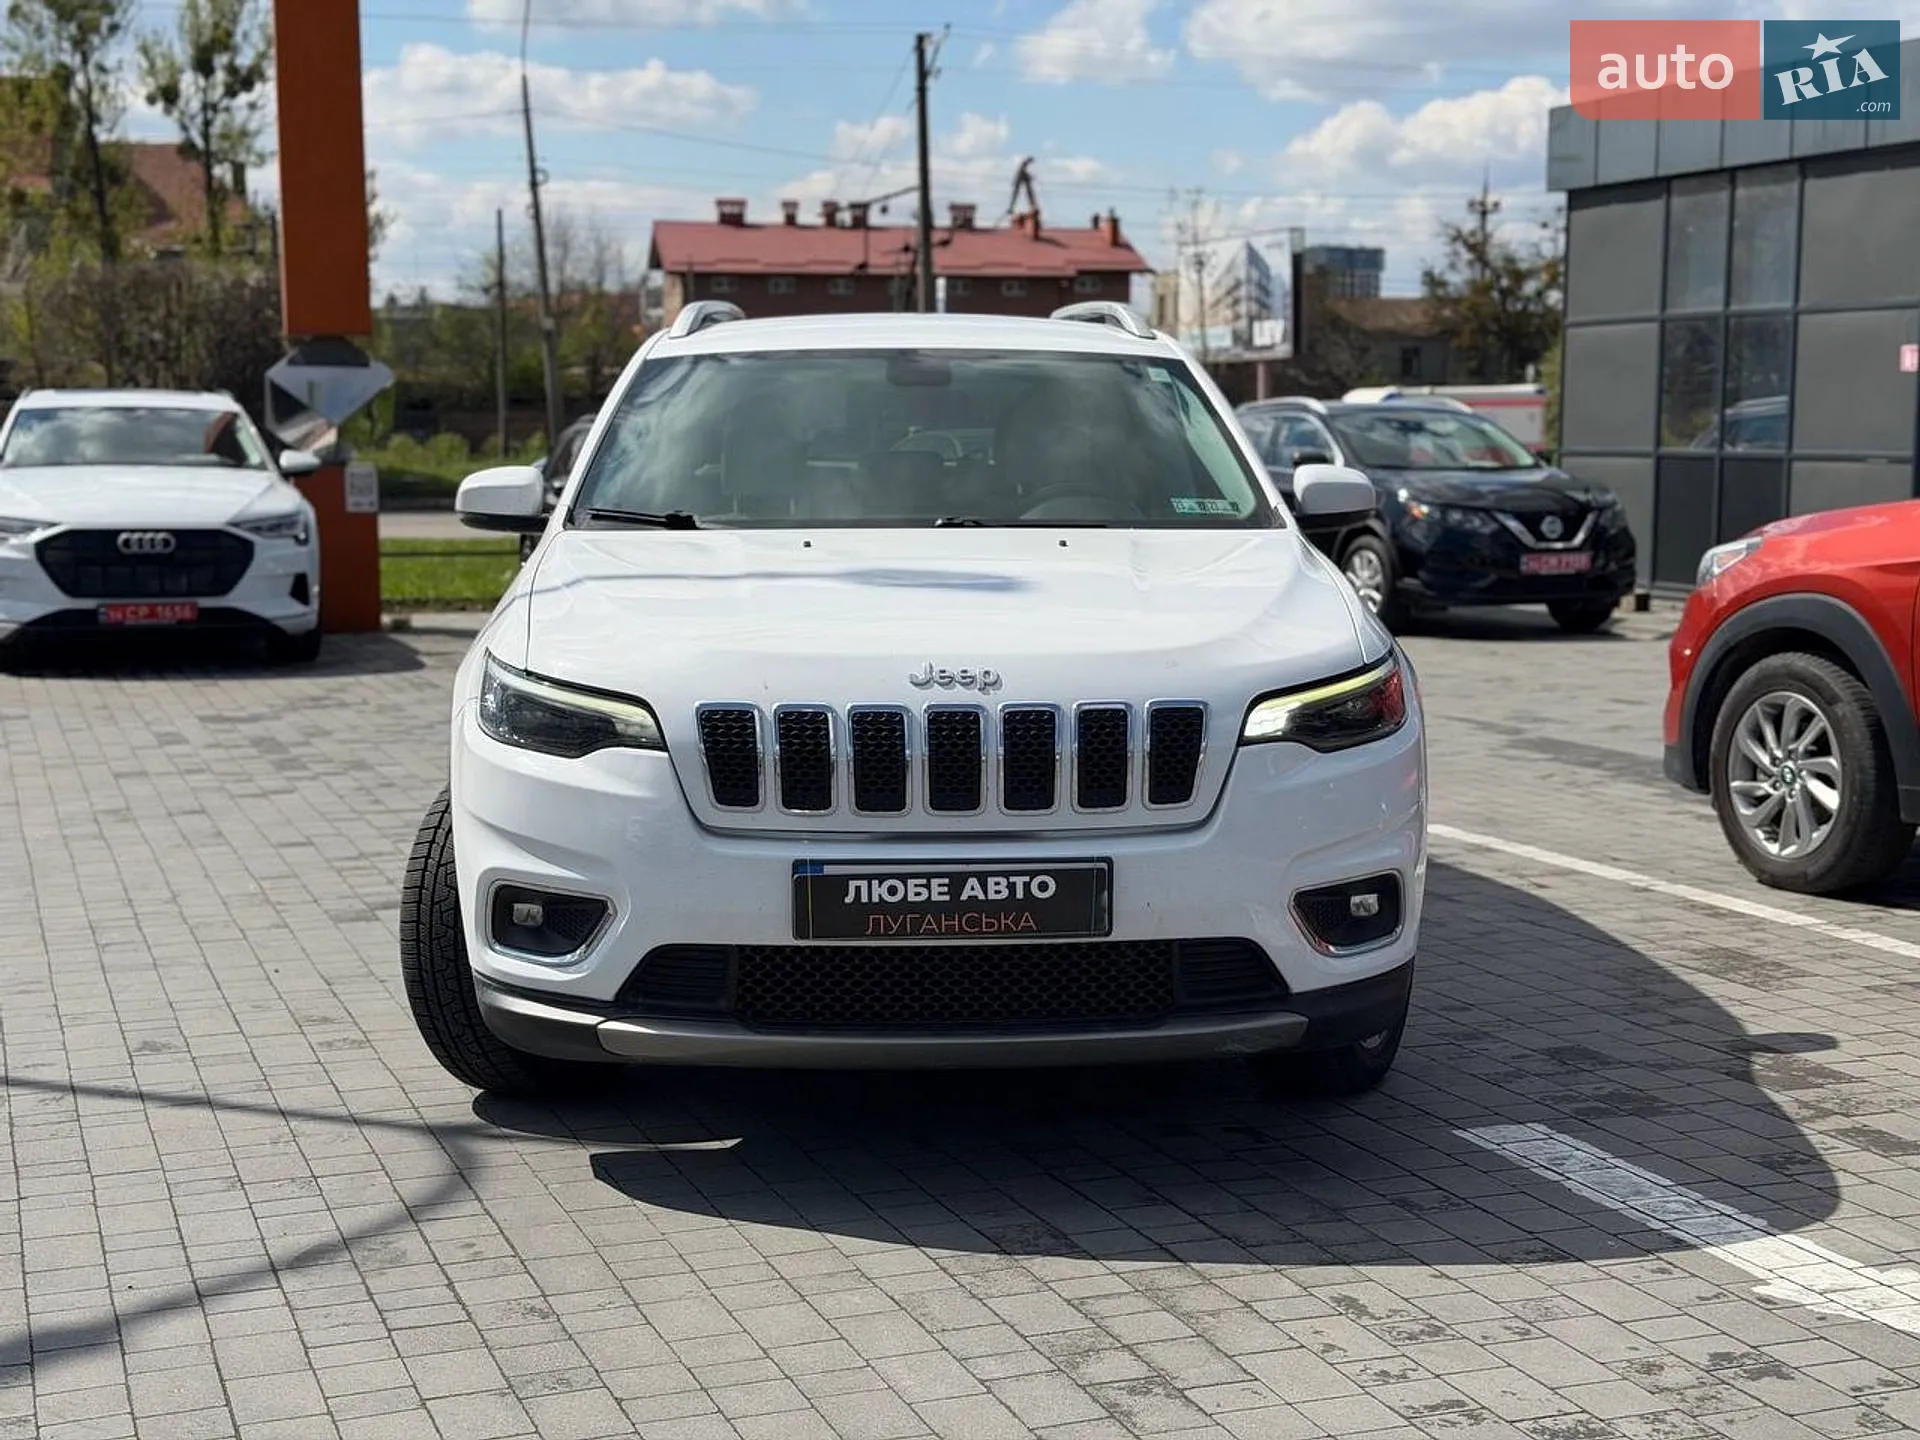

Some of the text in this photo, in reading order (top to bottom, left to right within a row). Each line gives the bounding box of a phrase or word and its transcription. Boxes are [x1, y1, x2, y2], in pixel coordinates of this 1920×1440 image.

[908, 660, 1002, 695] Jeep
[844, 874, 1057, 904] ЛЮБЕ АВТО
[865, 911, 1038, 936] ЛУГАНСЬКА
